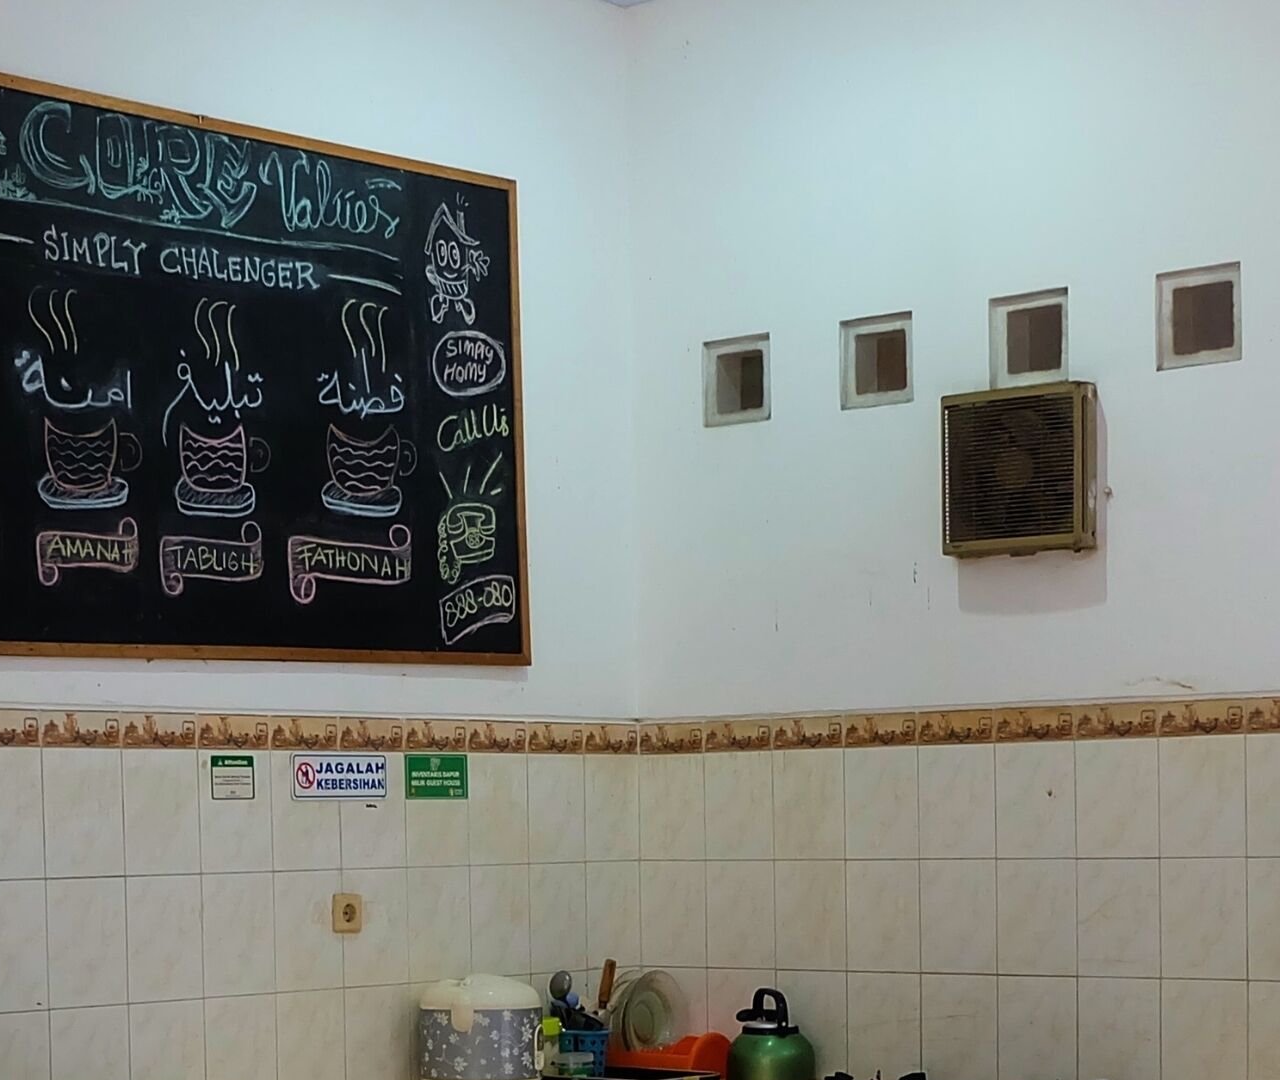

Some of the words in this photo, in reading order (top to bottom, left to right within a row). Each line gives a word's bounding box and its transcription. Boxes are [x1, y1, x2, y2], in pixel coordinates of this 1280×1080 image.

[20, 101, 257, 228] CORE
[43, 224, 146, 274] SIMPLY
[159, 246, 320, 290] CHALENGER
[437, 408, 482, 451] Call
[47, 534, 134, 562] AMANAH
[171, 546, 258, 575] TABLIGH
[298, 544, 410, 578] FATHONAH
[316, 762, 384, 774] JAGALAH
[316, 778, 384, 790] KEBERSIHAN
